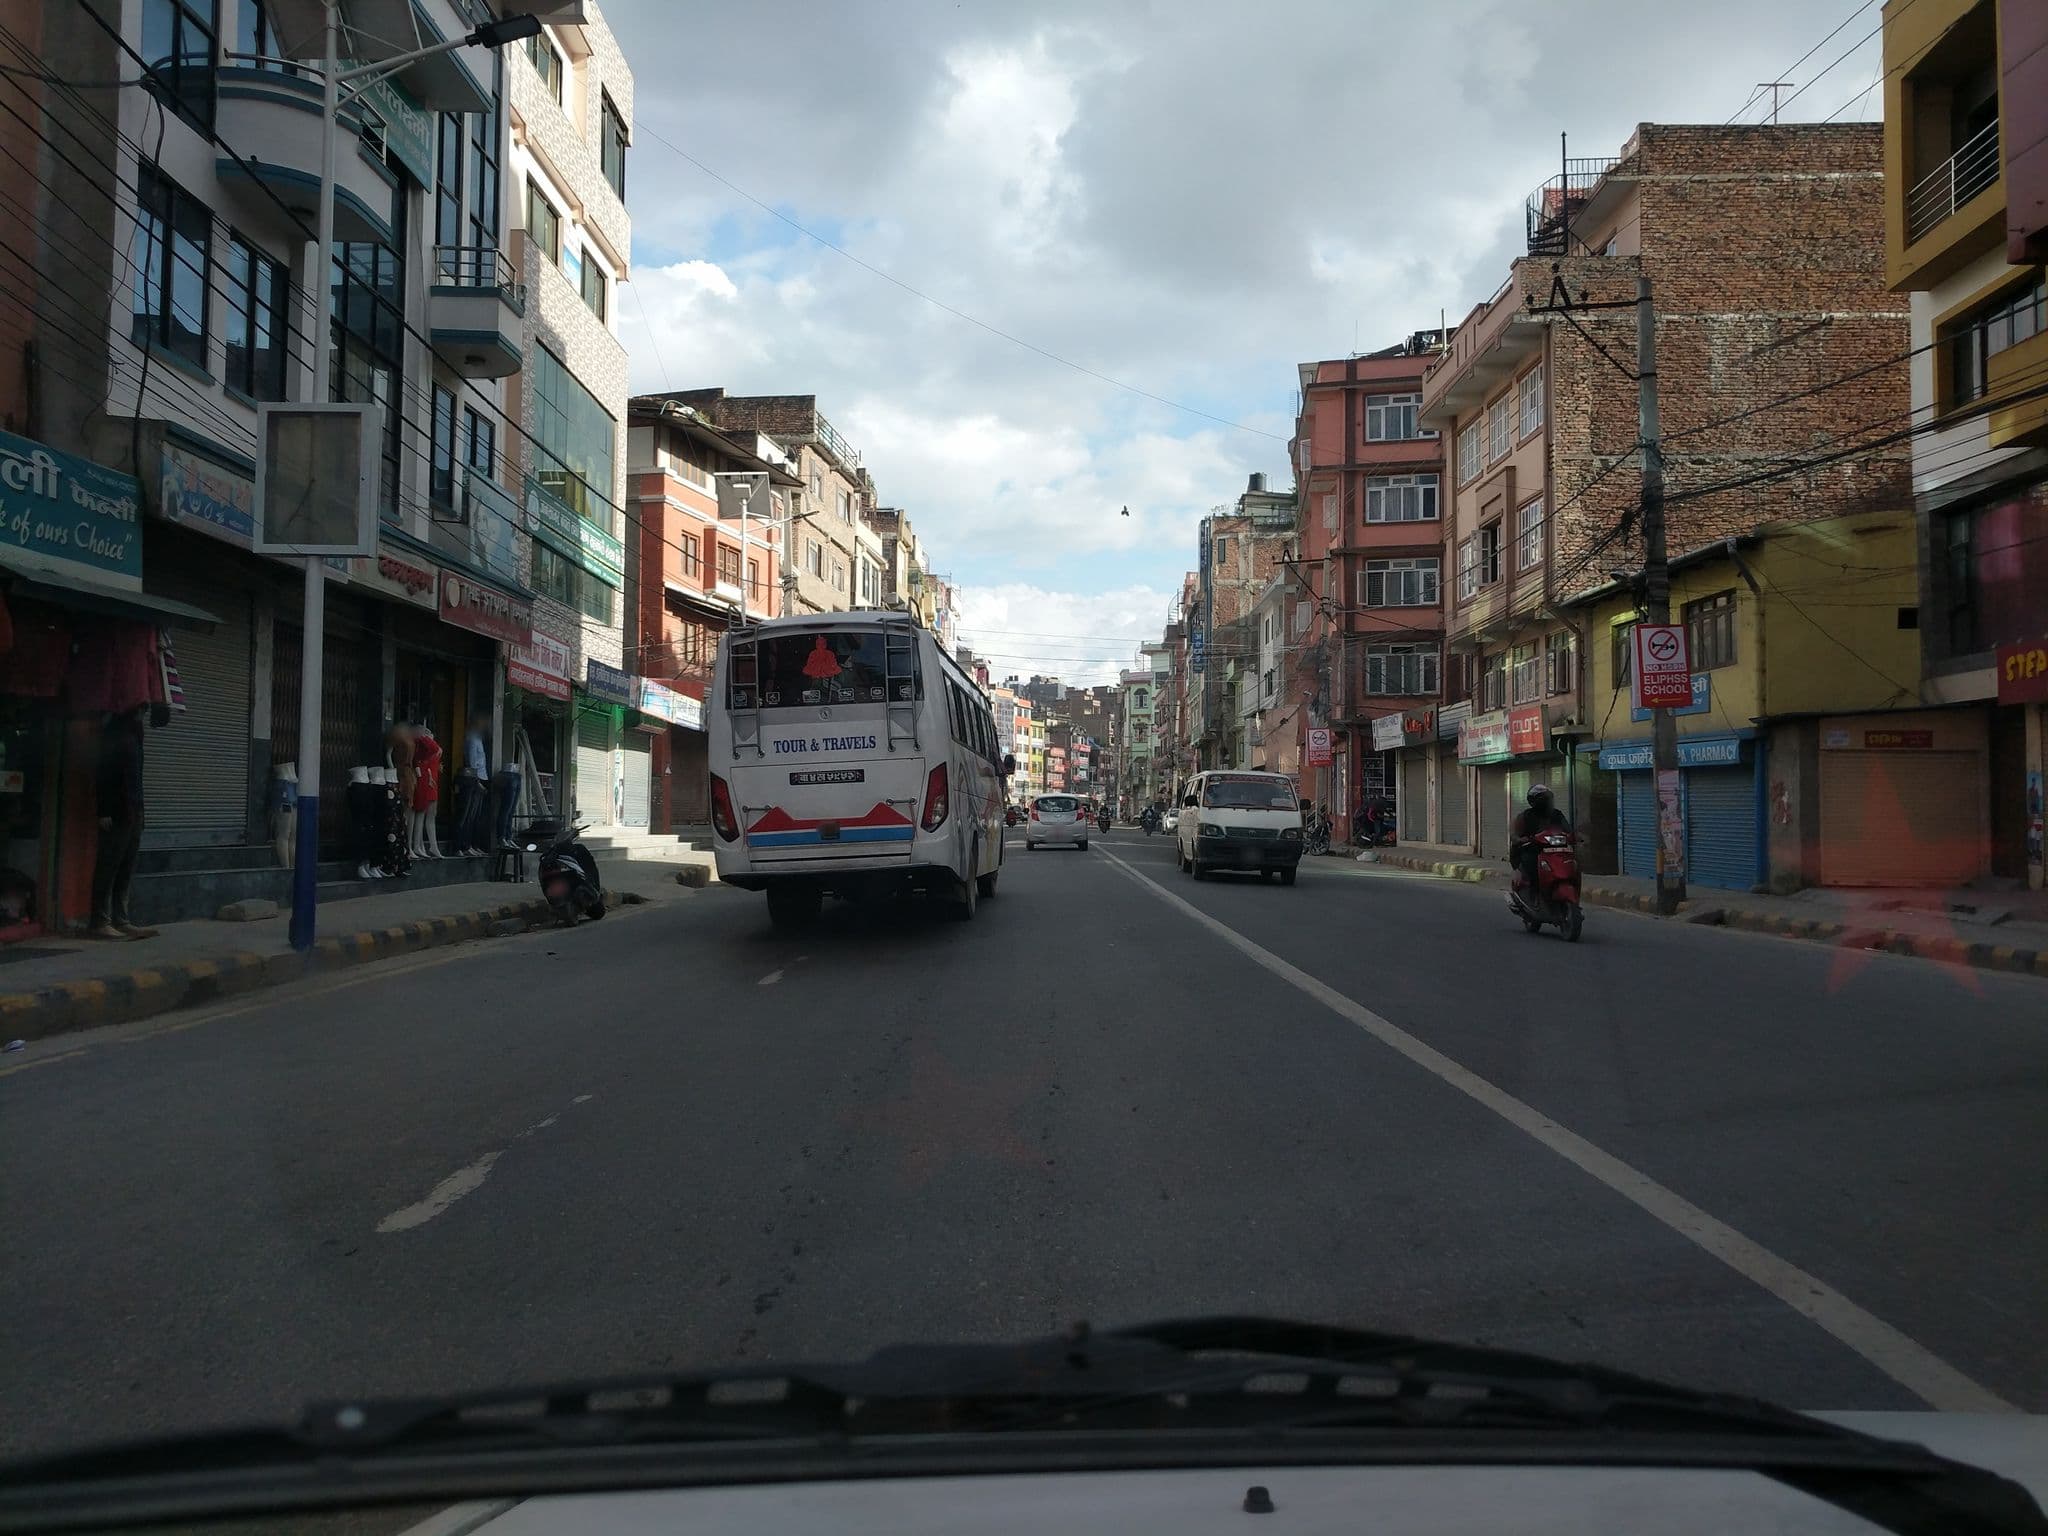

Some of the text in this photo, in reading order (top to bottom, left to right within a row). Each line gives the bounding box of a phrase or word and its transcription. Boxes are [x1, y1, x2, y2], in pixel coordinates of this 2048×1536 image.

[11, 508, 31, 544] of
[35, 521, 69, 545] ours
[1646, 664, 1660, 672] NO
[2006, 649, 2047, 681] STEP
[1643, 673, 1689, 685] ELIPHSS
[1643, 684, 1689, 695] SCHOOL
[773, 735, 877, 754] TOUR & TRAVELS
